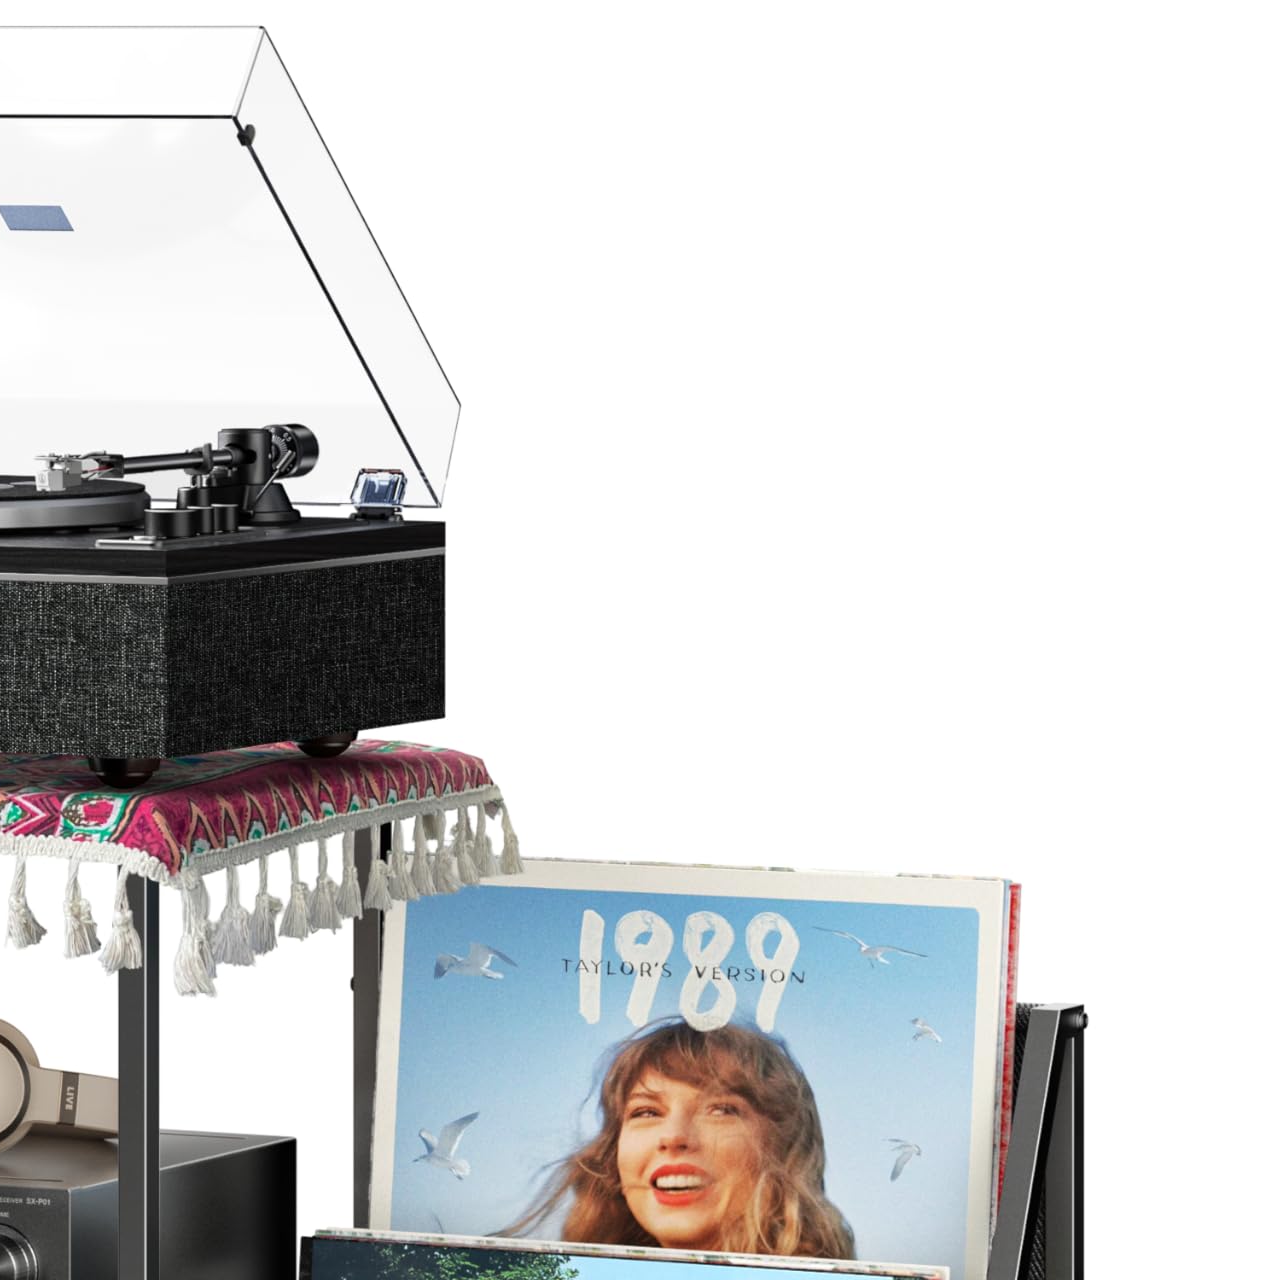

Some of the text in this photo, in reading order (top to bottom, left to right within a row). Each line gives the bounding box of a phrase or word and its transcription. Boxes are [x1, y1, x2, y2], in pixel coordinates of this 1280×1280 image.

[561, 958, 806, 984] TAYLOR'S VERSION
[578, 909, 800, 1033] 1989
[65, 1086, 75, 1110] LIVE
